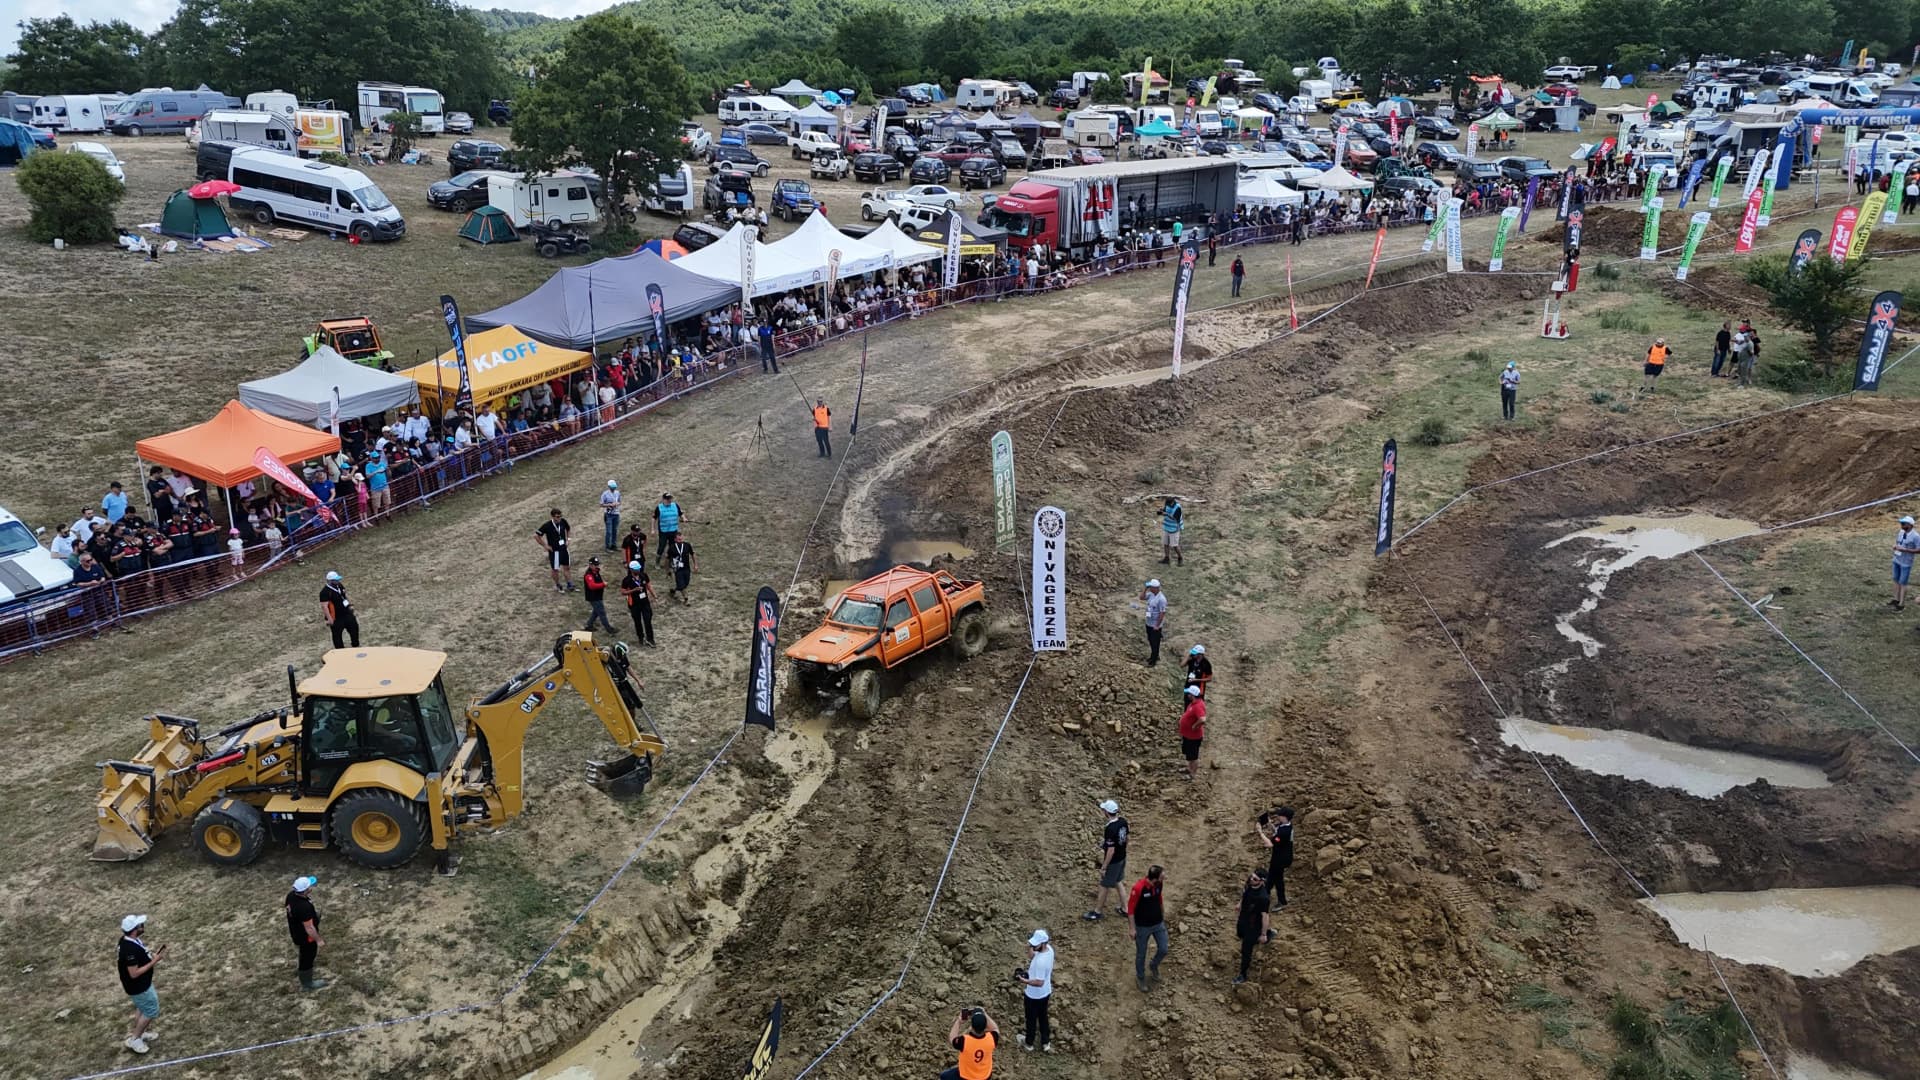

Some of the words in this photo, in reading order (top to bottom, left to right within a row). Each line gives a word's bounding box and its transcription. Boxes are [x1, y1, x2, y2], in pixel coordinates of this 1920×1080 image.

[1821, 115, 1859, 125] START
[1869, 115, 1911, 125] FINISH
[473, 341, 538, 374] KAOFF
[488, 386, 508, 397] KUZEY
[509, 379, 532, 390] ANKARA
[533, 372, 545, 382] OFF
[544, 368, 559, 377] ROAD
[1044, 540, 1056, 637] NIVAGEBZE
[1037, 639, 1066, 648] TEAM
[521, 694, 540, 713] CAT
[261, 754, 277, 766] 428
[974, 1050, 984, 1064] 9
